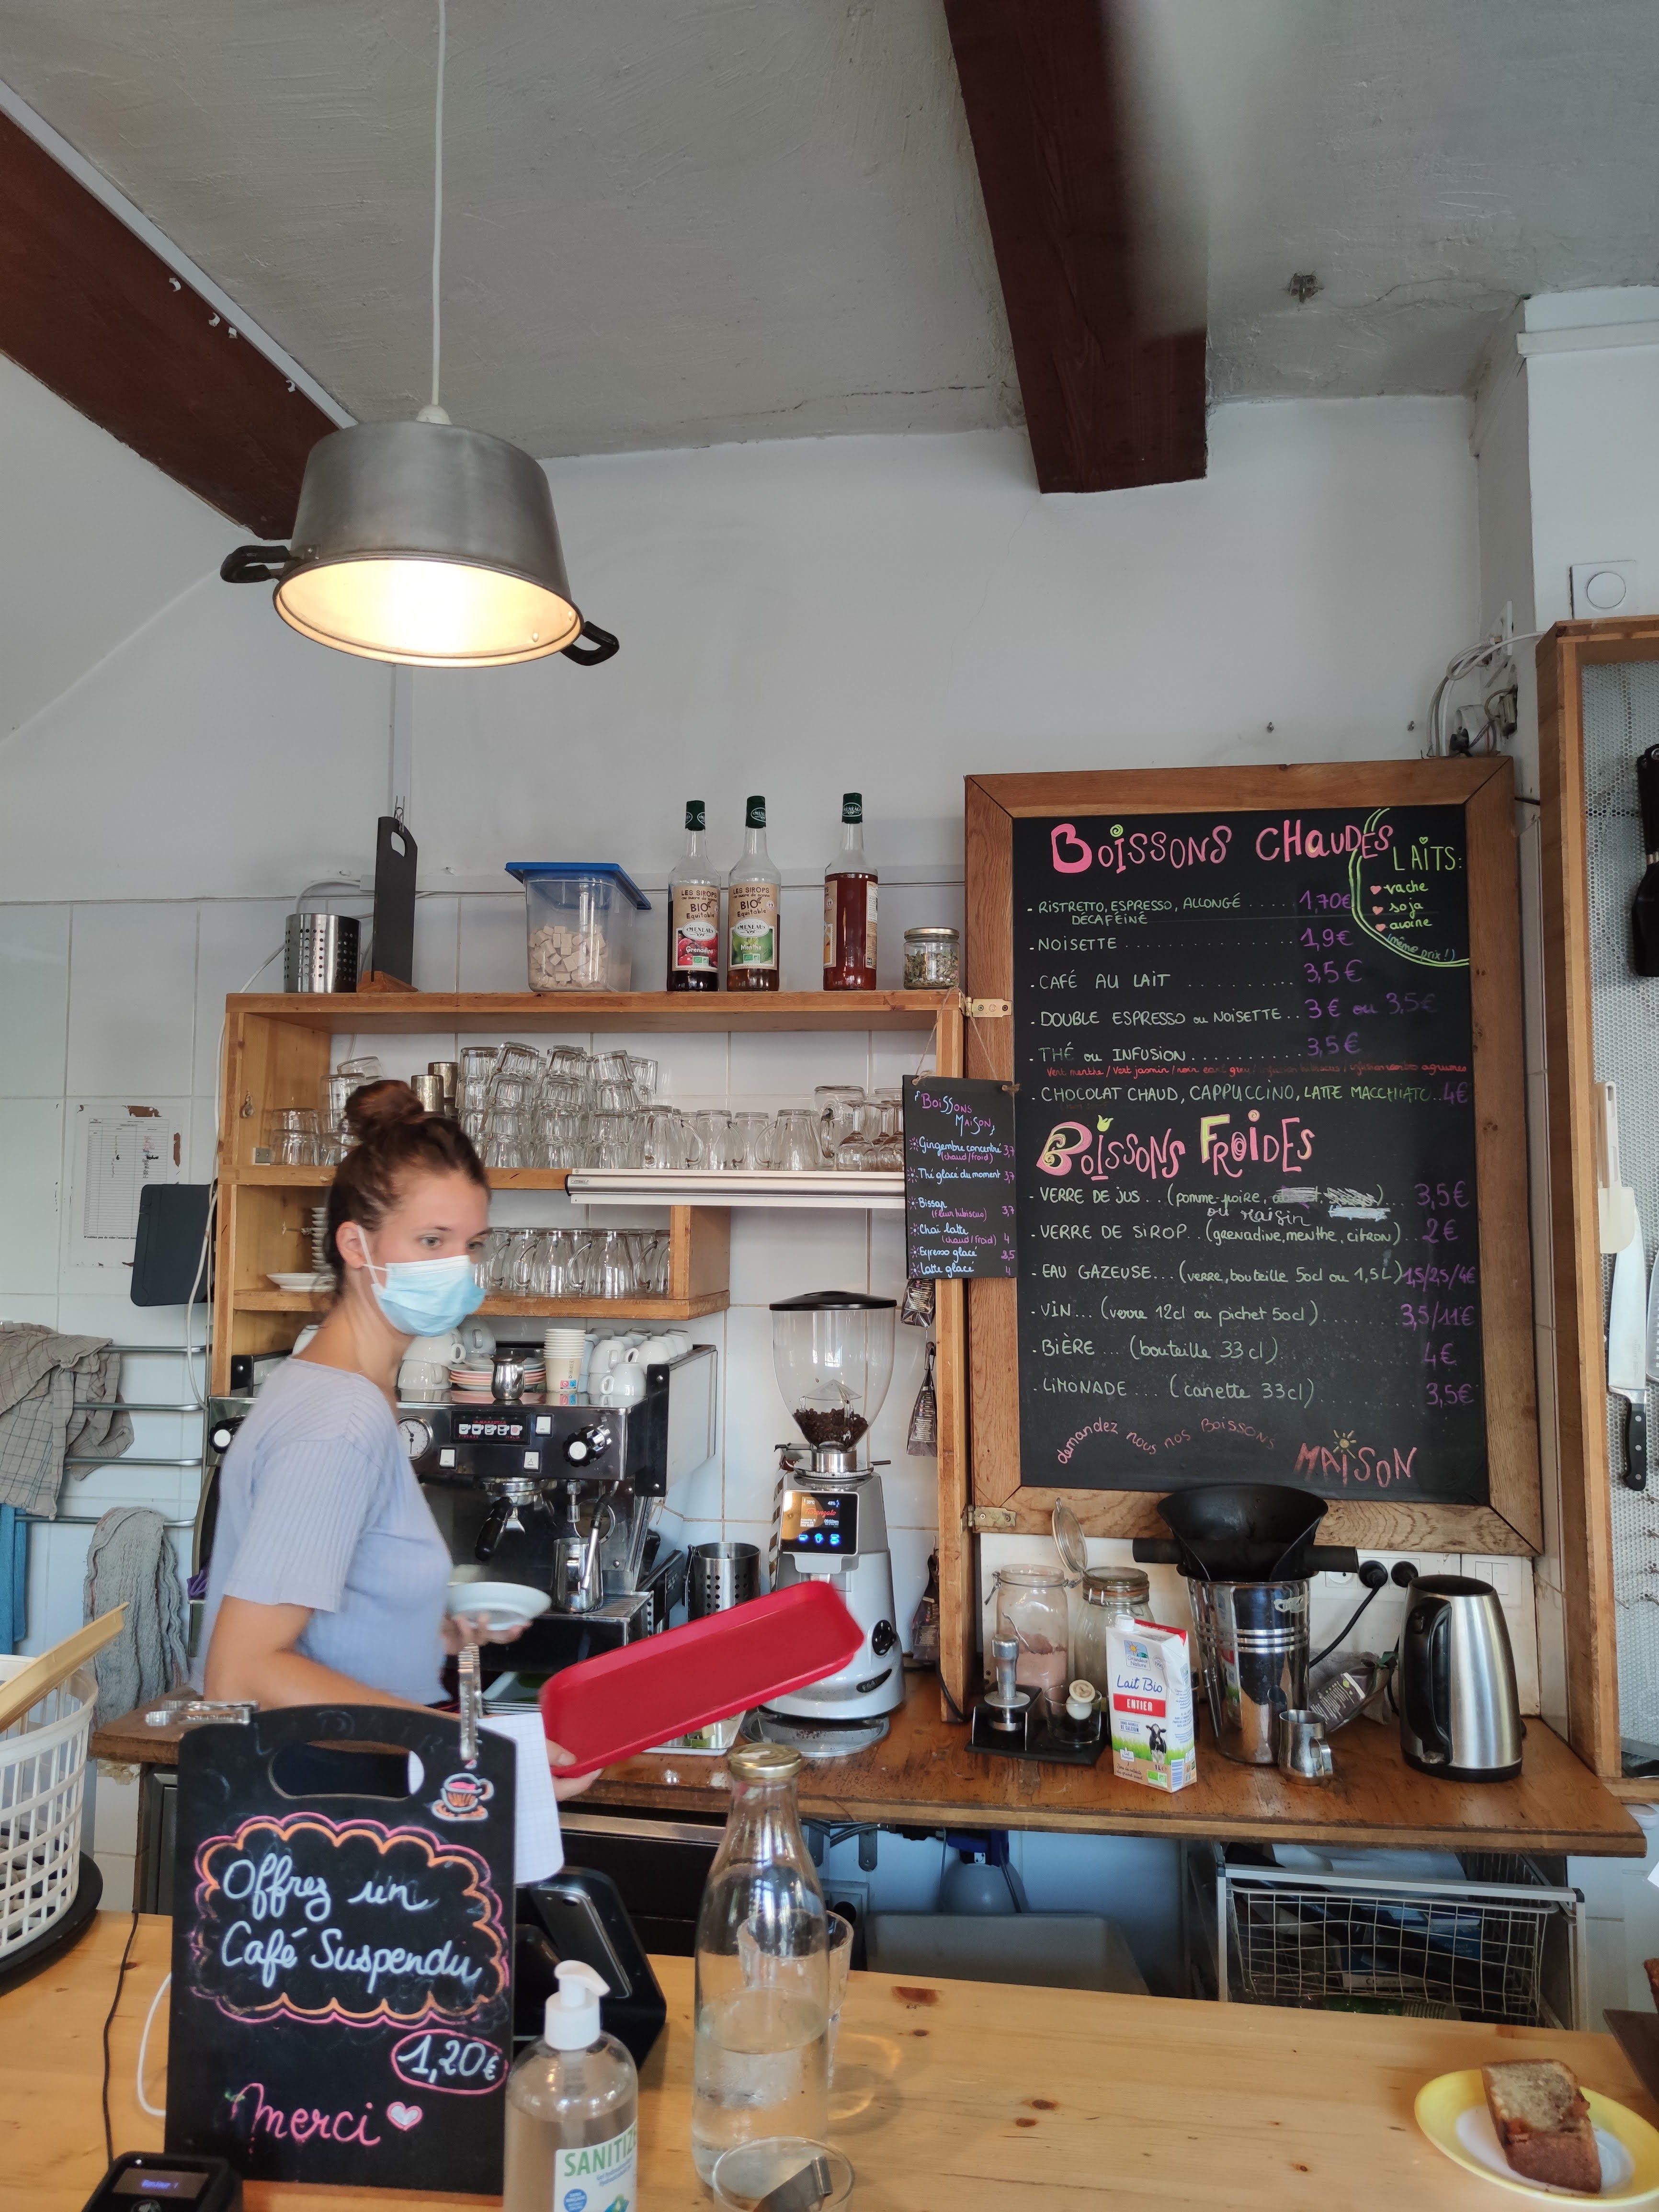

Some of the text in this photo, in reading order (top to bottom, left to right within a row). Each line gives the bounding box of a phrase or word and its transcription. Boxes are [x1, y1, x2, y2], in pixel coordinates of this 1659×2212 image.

[1383, 880, 1429, 893] vache
[691, 902, 709, 912] BIO
[737, 908, 766, 918] Equitable
[740, 899, 758, 910] BIO
[1389, 897, 1423, 919] soja
[1389, 917, 1432, 930] avoine
[1039, 969, 1078, 989] CAFÉ
[1095, 973, 1119, 989] AU
[1040, 1011, 1100, 1027] DOUBLE
[1112, 1011, 1186, 1026] ESPRESSO
[1193, 1015, 1209, 1024] ou
[1352, 1002, 1379, 1015] ou
[1083, 1052, 1102, 1062] ou
[1421, 1063, 1467, 1076] agrumes
[1041, 1086, 1122, 1102] CHOCOLAT
[1304, 1085, 1343, 1099] LATTE
[919, 1136, 965, 1156] Gingembre
[966, 1142, 1002, 1153] concentré
[918, 1166, 1015, 1185] Thé glacé du moment 3,7
[1040, 1186, 1084, 1204] VERRE
[1093, 1189, 1110, 1204] DE
[918, 1197, 947, 1211] Bissap
[1001, 1205, 1015, 1217] 3,7
[1240, 1207, 1312, 1226] raisin
[920, 1222, 969, 1235] Chaï latte
[1040, 1225, 1092, 1239] VERRE
[1102, 1225, 1123, 1239] DE
[920, 1246, 950, 1261] Expresso
[953, 1246, 978, 1263] glacé
[945, 1261, 975, 1278] glacé
[1005, 1266, 1011, 1276] 4
[1042, 1264, 1067, 1278] EAU
[1078, 1265, 1151, 1279] GAZEUSE
[1230, 1267, 1288, 1282] bouteille
[1329, 1274, 1349, 1282] ou
[1194, 1311, 1212, 1319] ou
[1219, 1306, 1267, 1327] pichet
[1057, 1416, 1118, 1464] demandez
[1126, 1432, 1157, 1454] nous
[1164, 1429, 1191, 1449] nos
[1127, 1655, 1148, 1664] Grandeur
[1117, 1675, 1162, 1693] Lait Bio
[1127, 1698, 1153, 1711] ENTIER
[223, 1853, 429, 1921] Offrez un
[221, 1921, 483, 1994] Café Suspendu
[398, 2035, 499, 2083] 1,20€
